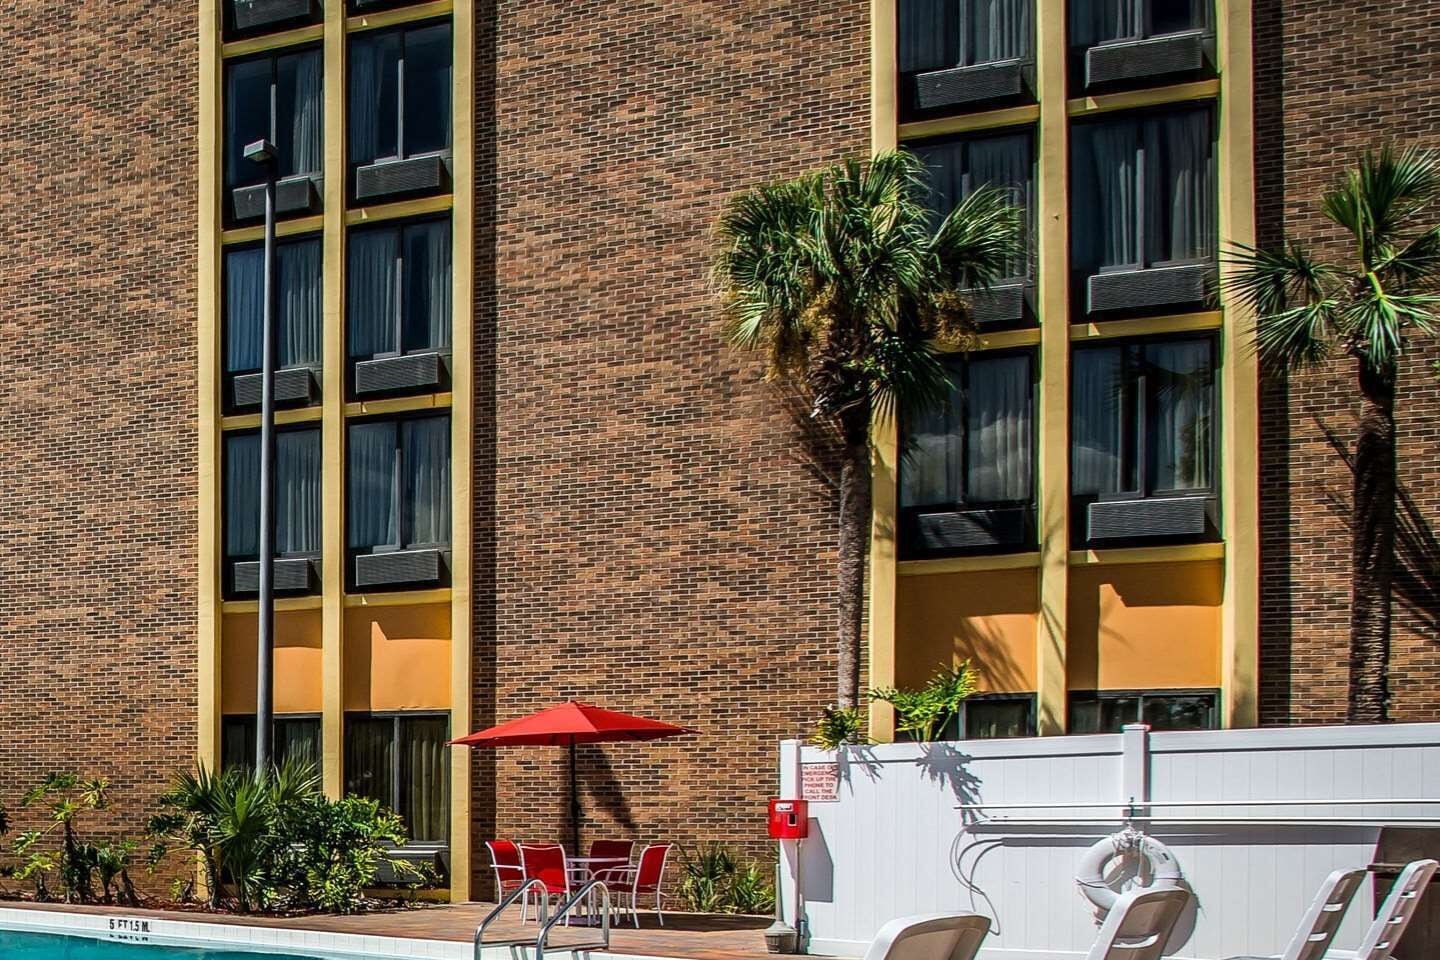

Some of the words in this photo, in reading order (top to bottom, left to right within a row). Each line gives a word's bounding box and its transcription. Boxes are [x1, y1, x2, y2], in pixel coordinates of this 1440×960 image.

[109, 918, 115, 930] 5
[118, 919, 128, 929] FT
[129, 920, 140, 931] 1.5
